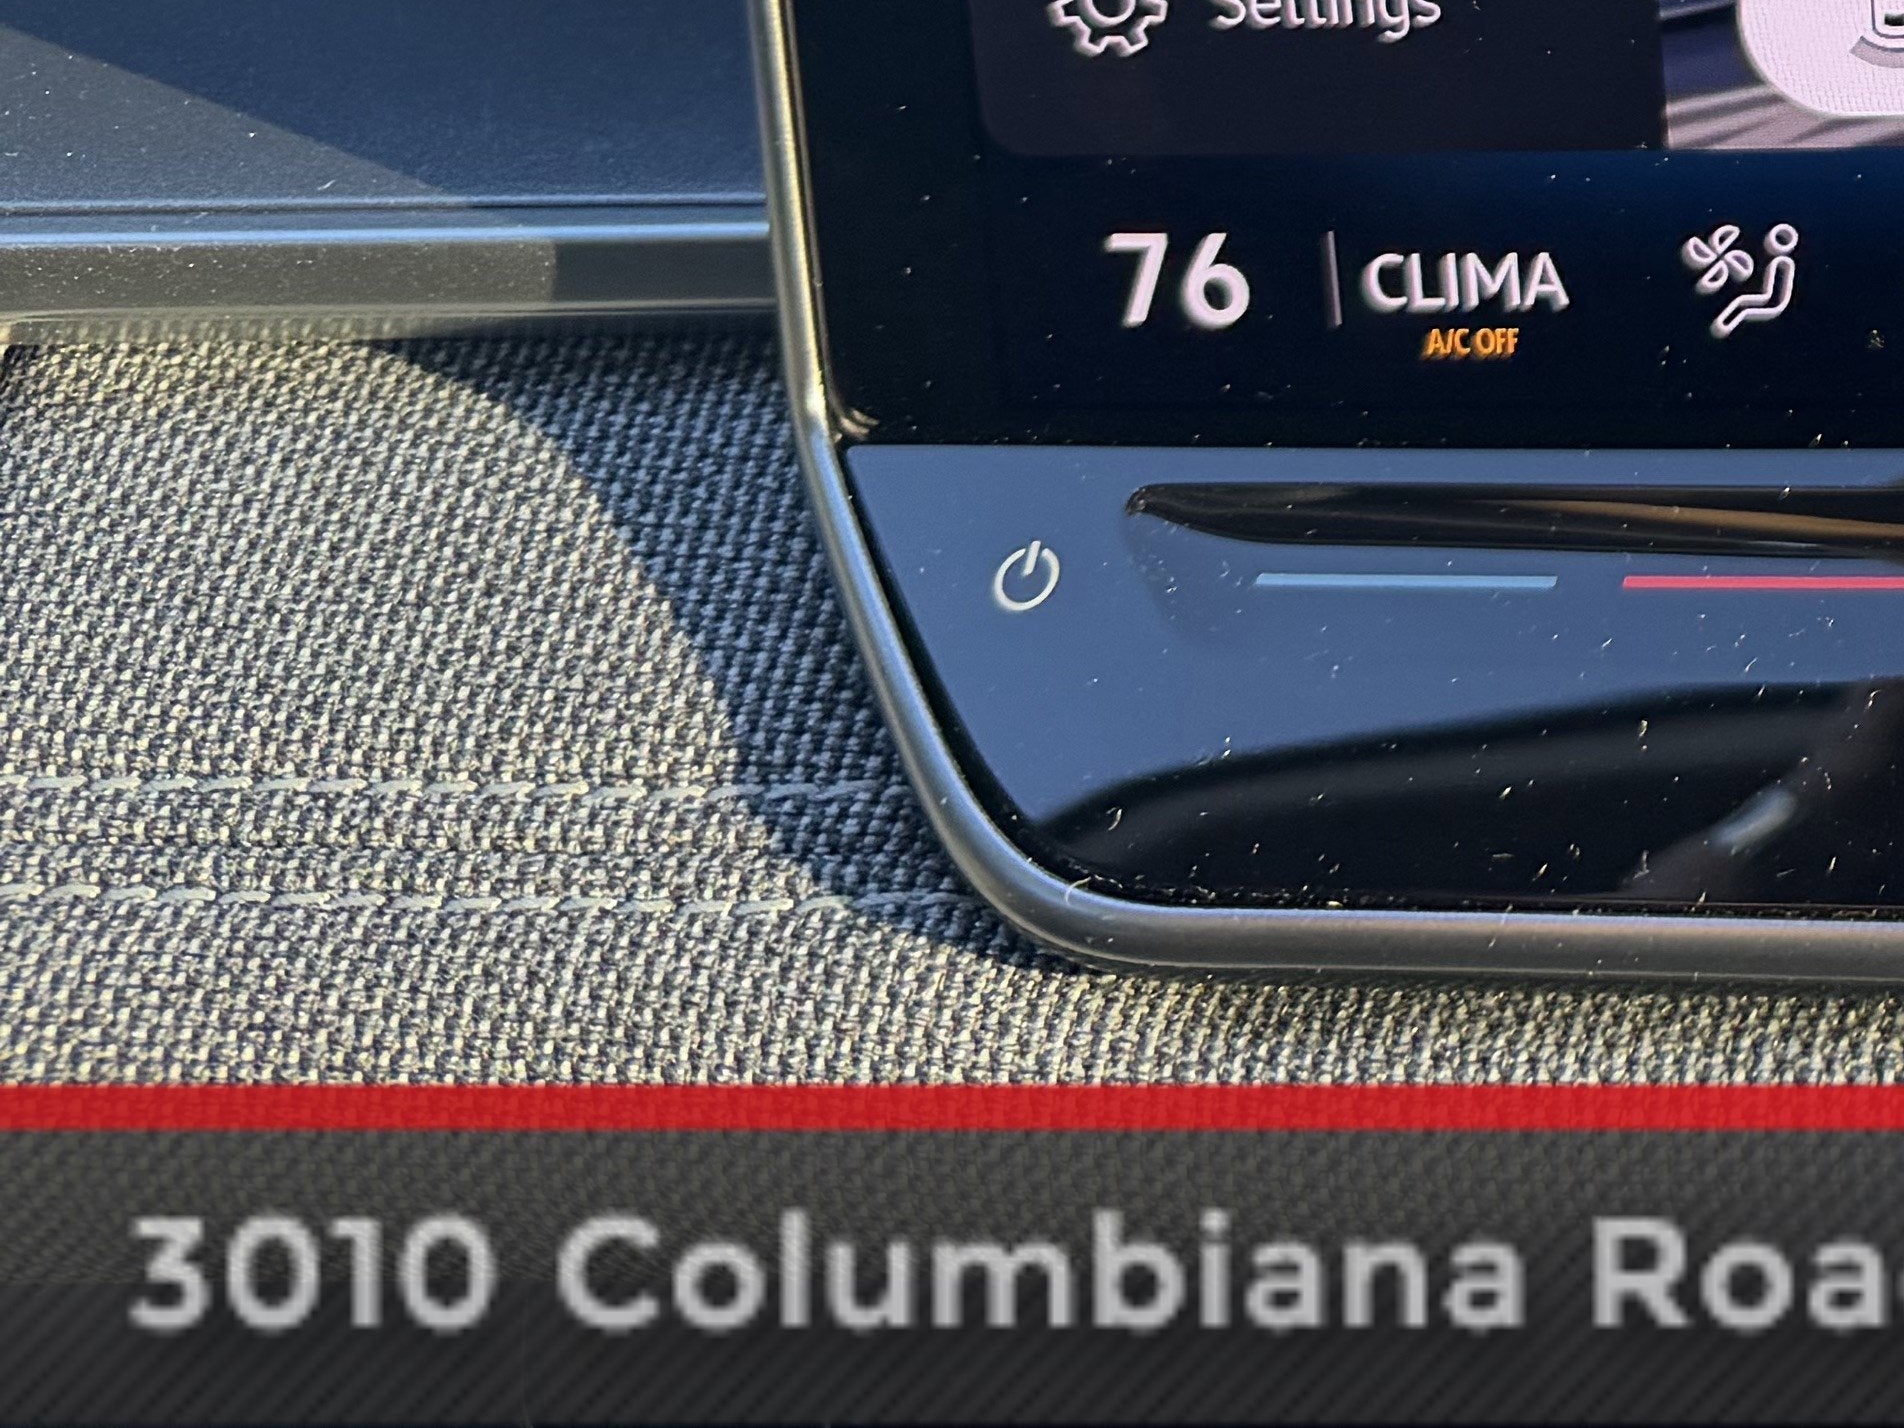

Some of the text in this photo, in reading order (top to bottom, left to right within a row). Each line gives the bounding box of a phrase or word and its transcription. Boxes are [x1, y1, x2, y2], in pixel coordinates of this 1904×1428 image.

[1104, 232, 1251, 329] 76
[1362, 252, 1571, 313] CLIMA
[1423, 327, 1520, 357] A/C OFF
